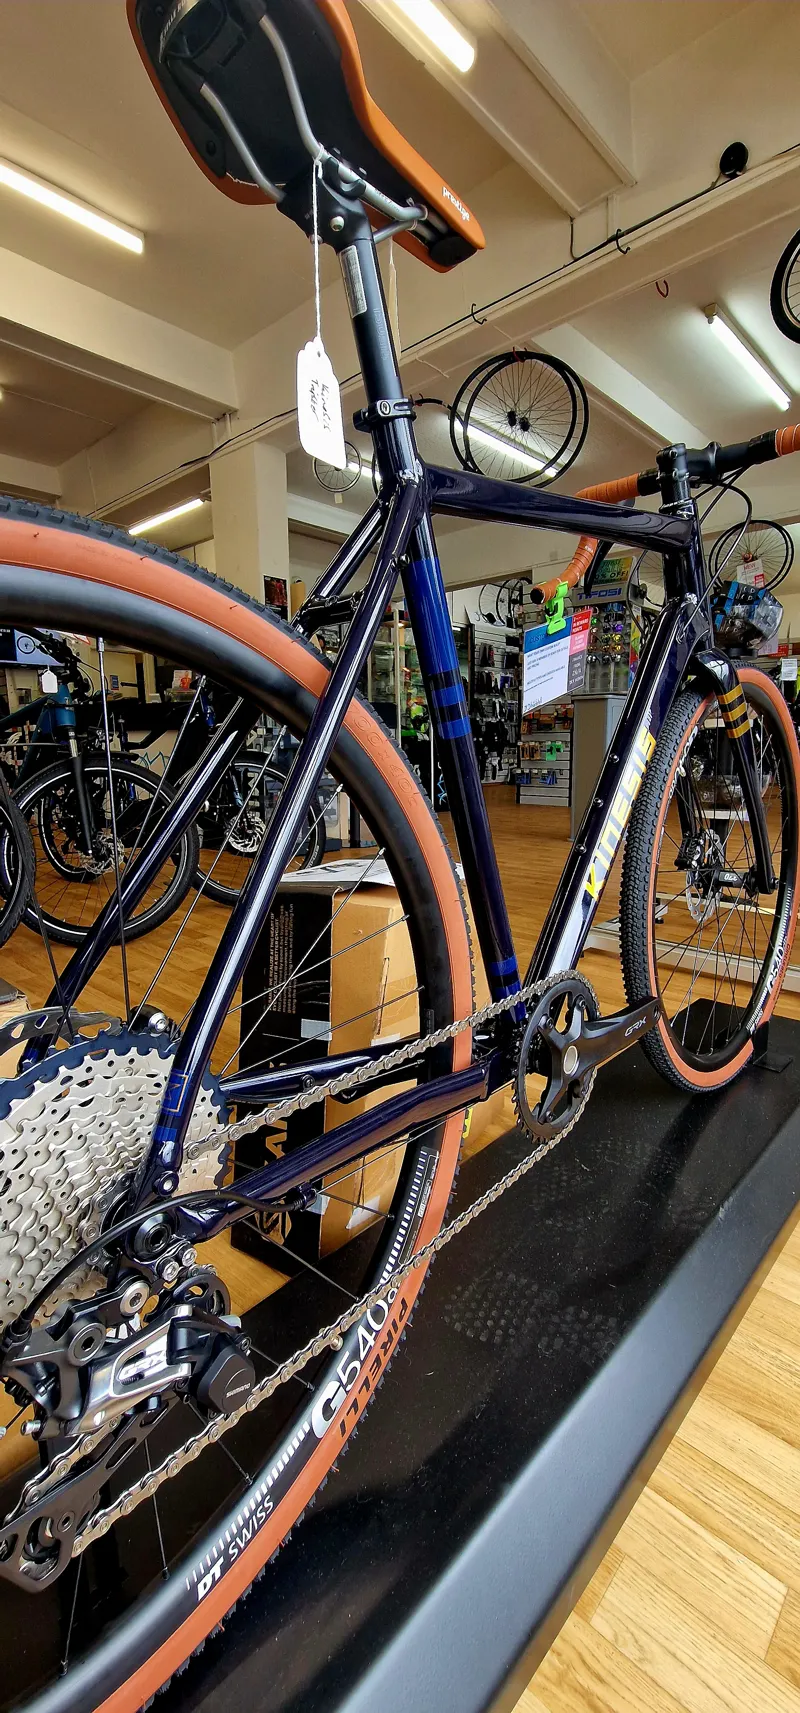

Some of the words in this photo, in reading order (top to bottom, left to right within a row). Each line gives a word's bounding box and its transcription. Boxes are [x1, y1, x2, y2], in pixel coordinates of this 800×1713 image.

[441, 186, 471, 222] prestige
[577, 588, 622, 600] TIFOSI
[624, 1016, 646, 1037] GRX
[312, 1299, 390, 1440] G540
[338, 1296, 410, 1438] PIRELLI
[226, 1382, 251, 1398] SHIMANO
[197, 1558, 224, 1602] DT
[228, 1494, 274, 1562] SWISS
